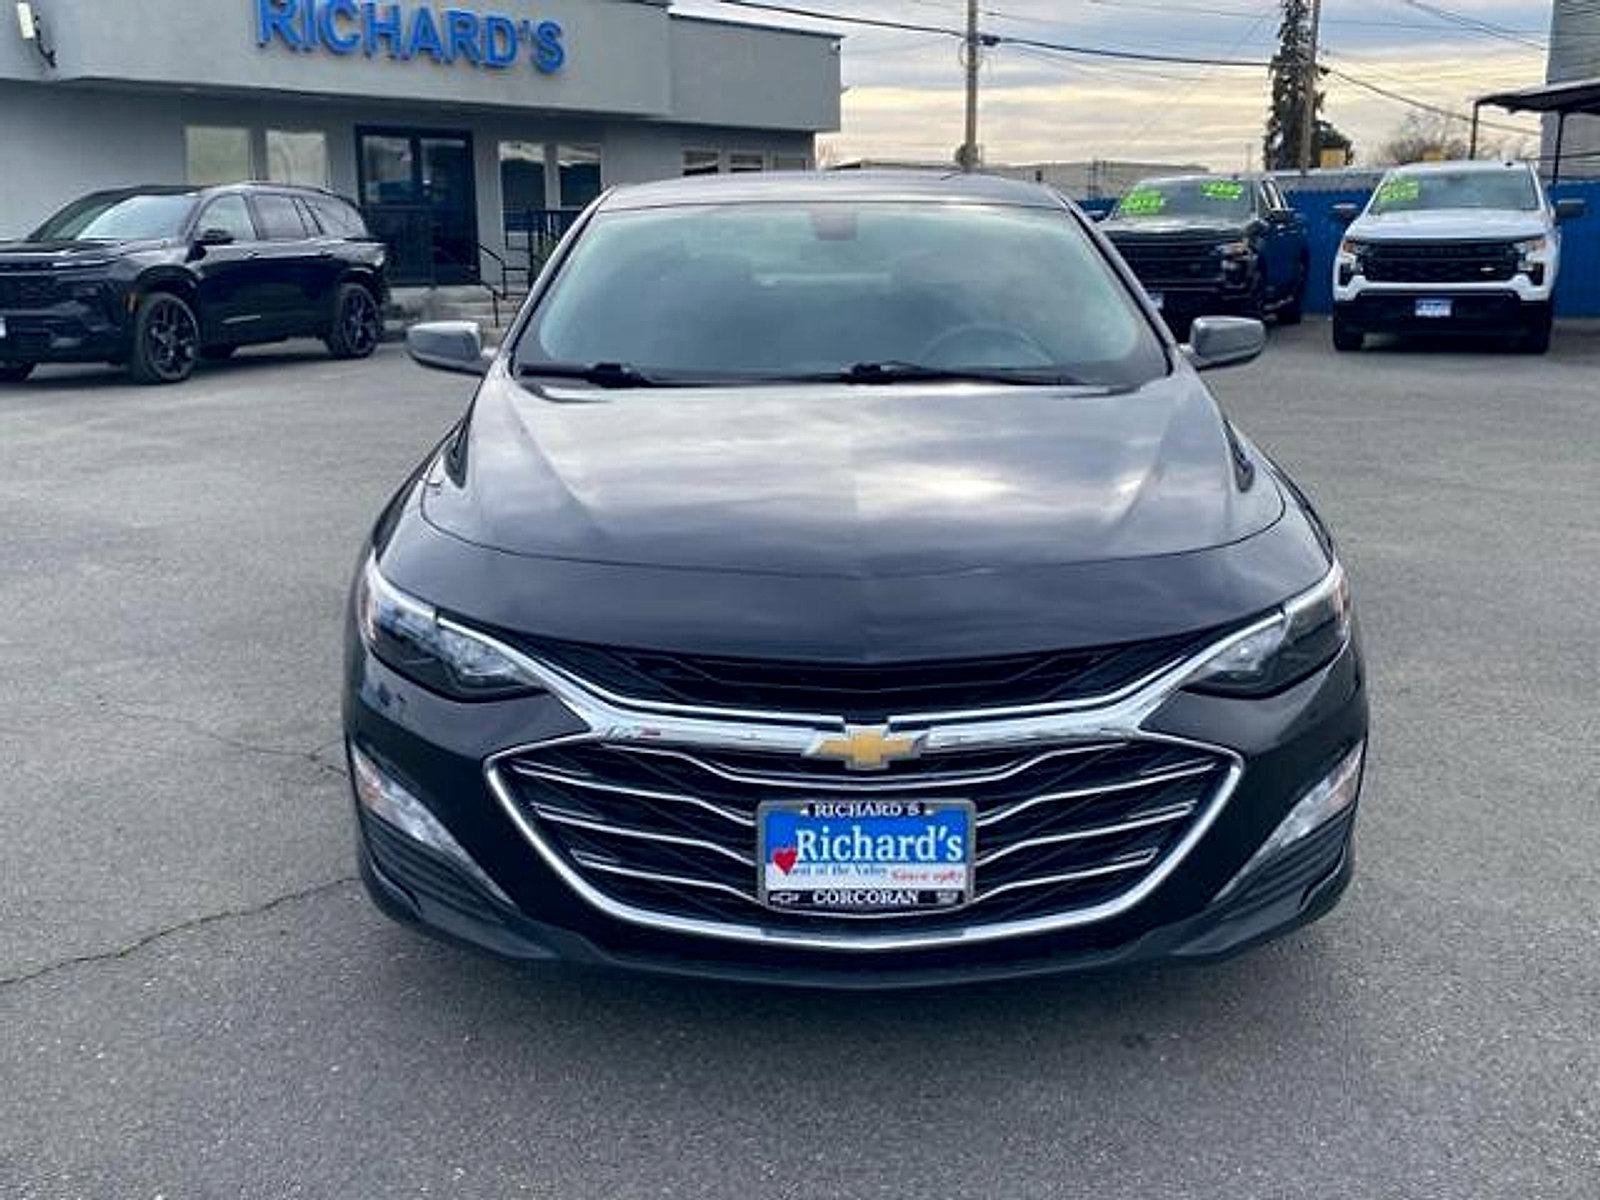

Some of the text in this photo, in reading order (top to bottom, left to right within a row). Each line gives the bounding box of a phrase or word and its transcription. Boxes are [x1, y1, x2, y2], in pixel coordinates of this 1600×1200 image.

[256, 0, 564, 74] RICHARD'S
[796, 826, 964, 861] Richard's
[812, 889, 918, 904] CORCORAN
